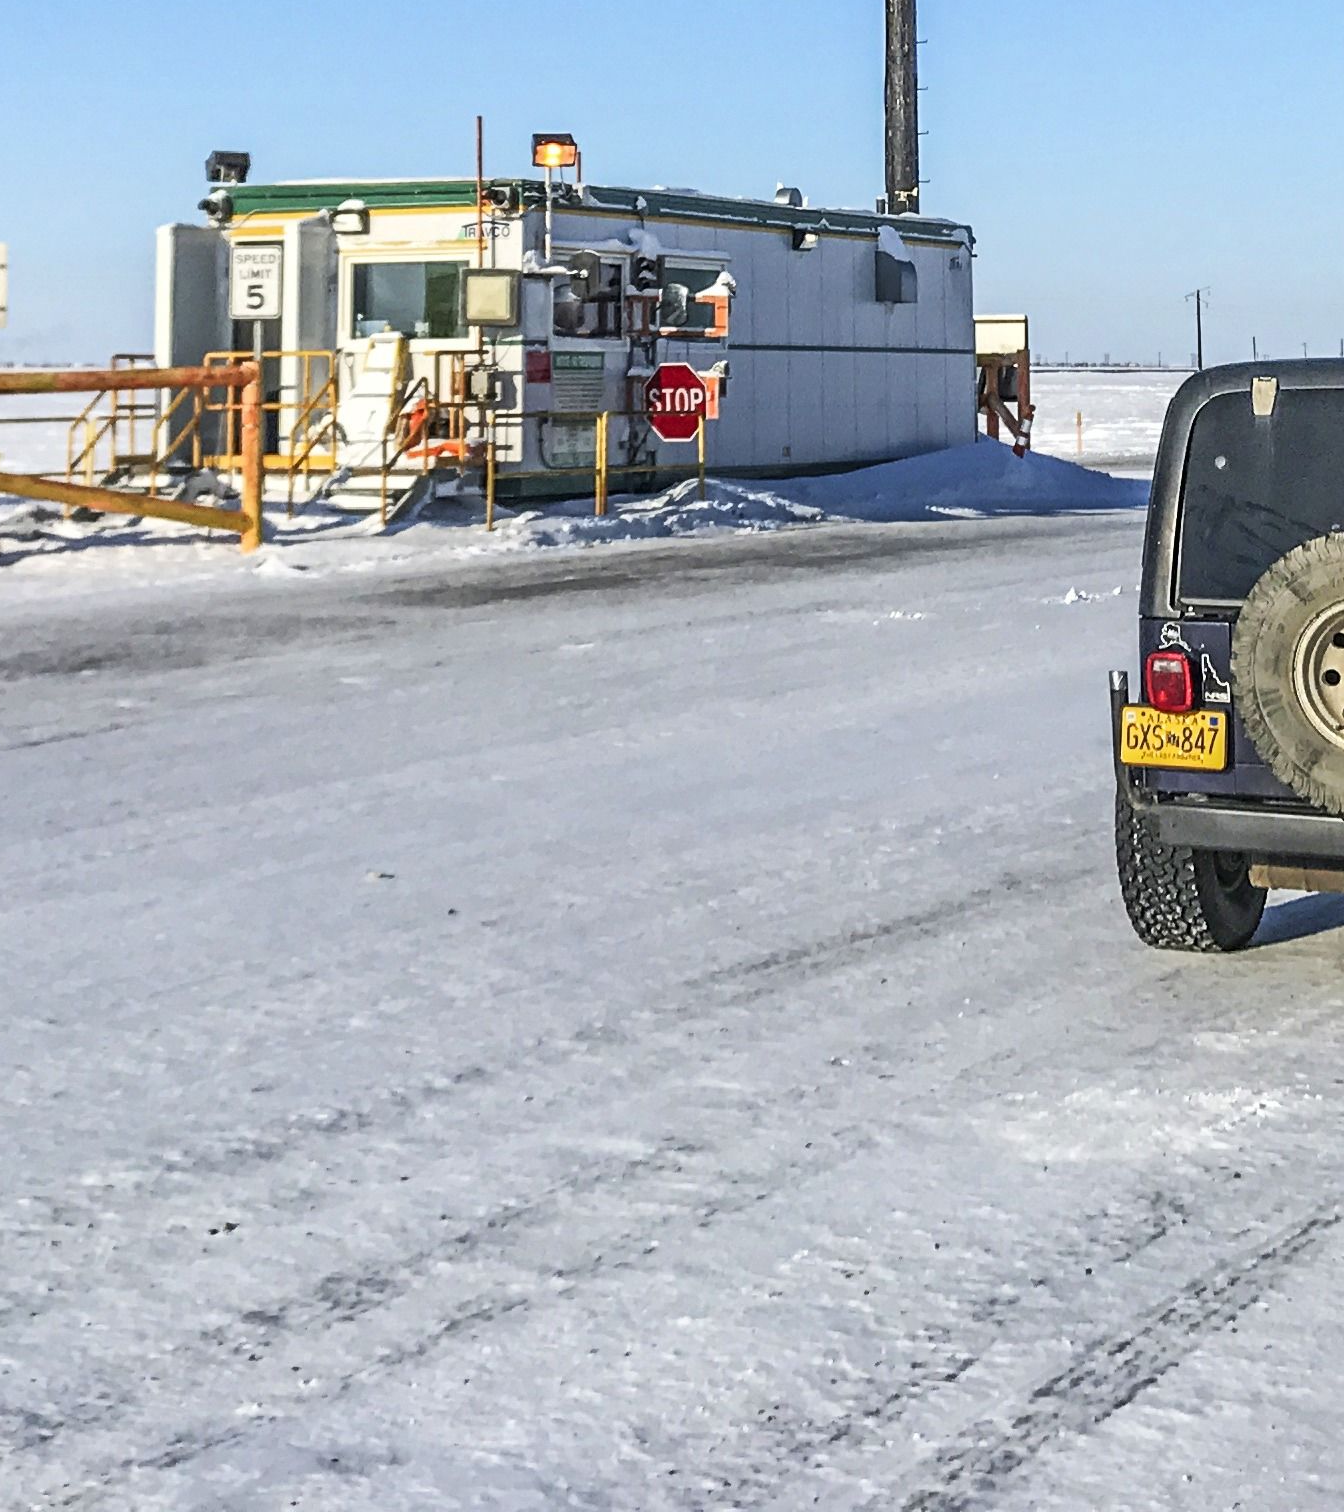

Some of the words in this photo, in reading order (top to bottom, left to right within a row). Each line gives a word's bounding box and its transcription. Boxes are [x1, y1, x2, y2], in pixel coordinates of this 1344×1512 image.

[235, 254, 276, 264] SPEED
[239, 269, 272, 280] LIMIT
[246, 284, 265, 310] 5
[649, 388, 703, 412] STOP
[1147, 713, 1198, 726] ALASKA
[1127, 723, 1164, 751] GXS
[1181, 726, 1219, 756] 847
